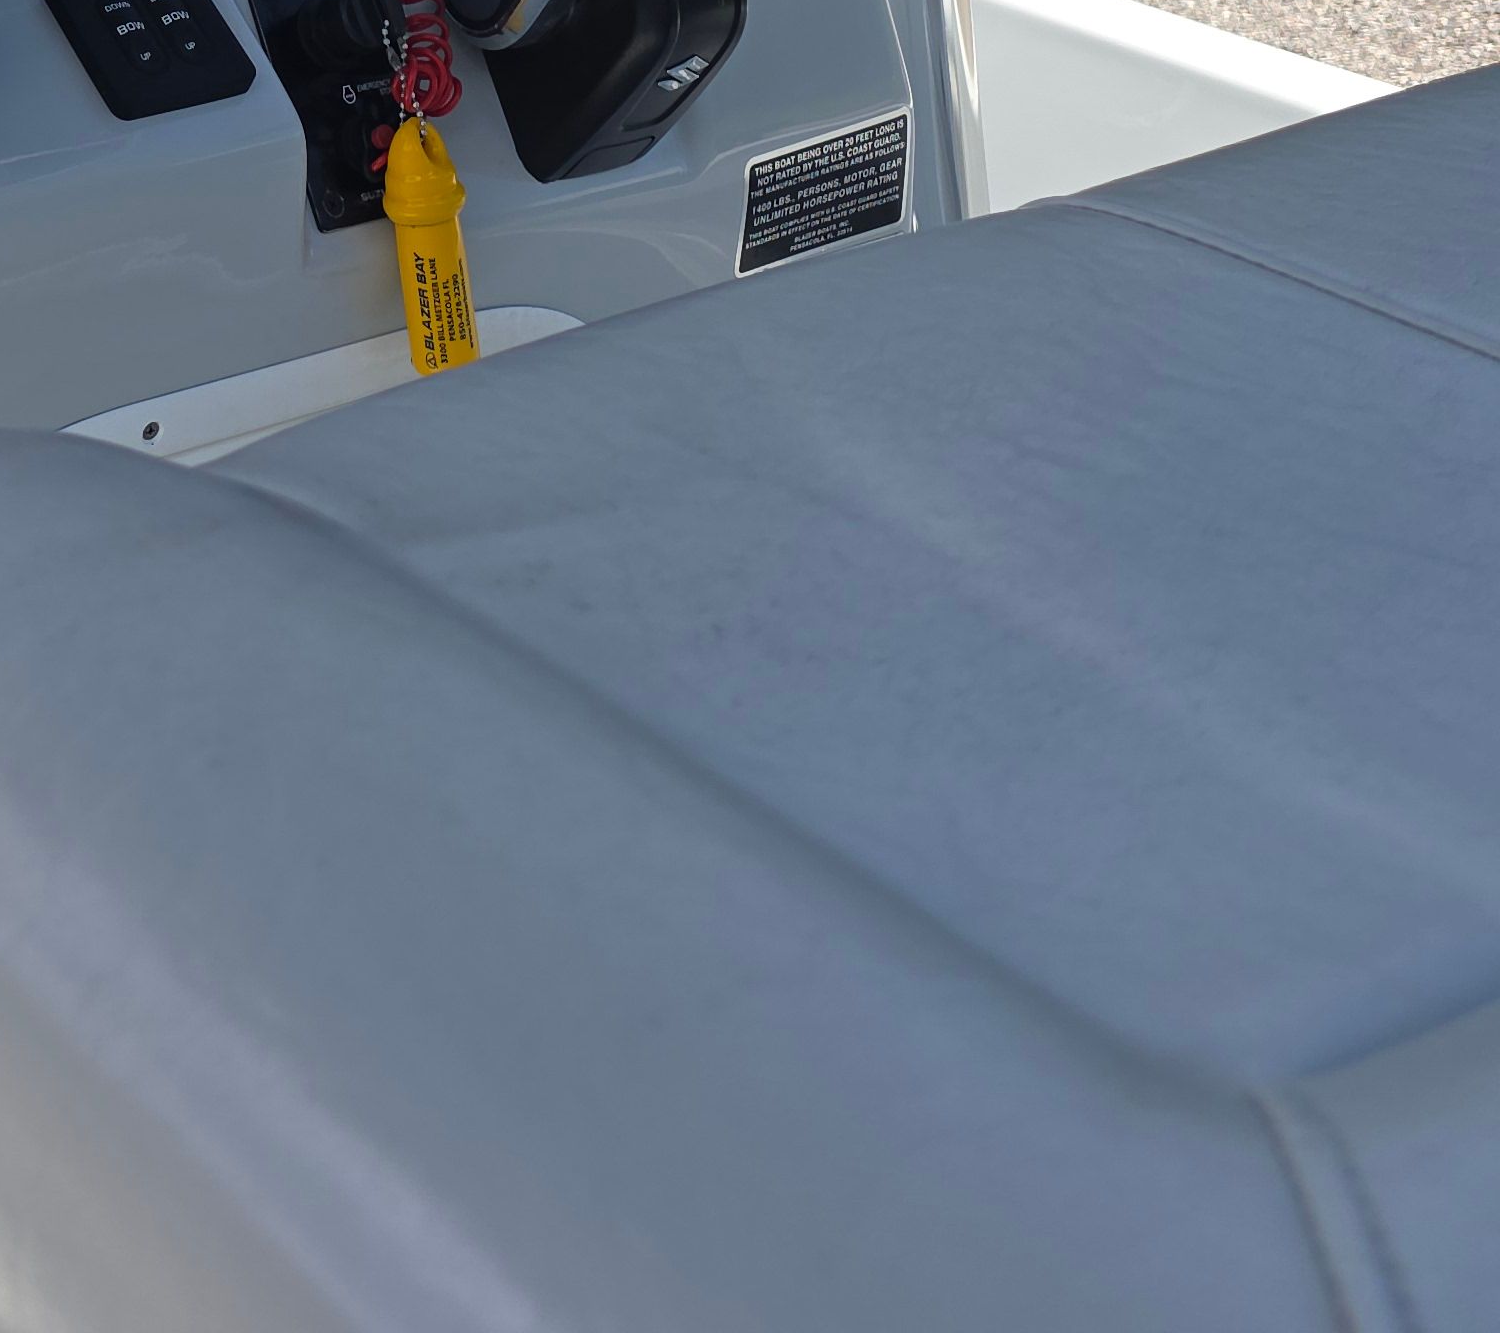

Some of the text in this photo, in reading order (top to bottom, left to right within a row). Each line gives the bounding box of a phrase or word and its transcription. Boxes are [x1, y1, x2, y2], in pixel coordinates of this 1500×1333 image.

[104, 1, 131, 13] DOWN
[116, 21, 146, 36] BOW
[161, 10, 190, 26] BOW
[140, 51, 151, 61] UP
[184, 41, 196, 50] UP
[754, 118, 904, 177] THIS BOAT BEING OVER 20 FEET LONG IS
[757, 174, 774, 188] NOT
[775, 167, 801, 181] RATED
[802, 162, 813, 173] BY
[814, 155, 830, 168] THE
[830, 151, 846, 162] U.S.
[846, 142, 873, 158] COAST
[750, 188, 764, 199] THE
[765, 170, 820, 194] MANUFACTURER
[850, 155, 864, 166] ARE
[864, 152, 874, 162] AS
[752, 200, 772, 216] 1400
[879, 157, 903, 173] GEAR
[753, 171, 898, 227] UNLIMITED HORSEPOWER RATING
[763, 224, 779, 236] BOAT
[837, 200, 857, 212] COAST
[857, 193, 878, 206] GUARD
[878, 185, 900, 198] SAFETY
[787, 223, 811, 237] EFFECT
[820, 214, 832, 225] THE
[856, 193, 900, 213] CERTIFICATION
[413, 252, 436, 351] BLAZER BAY
[428, 257, 449, 364] 3300 BILL METZGER LANE
[443, 292, 456, 342] PENSACOLA
[451, 273, 467, 341] 850-478-2290
